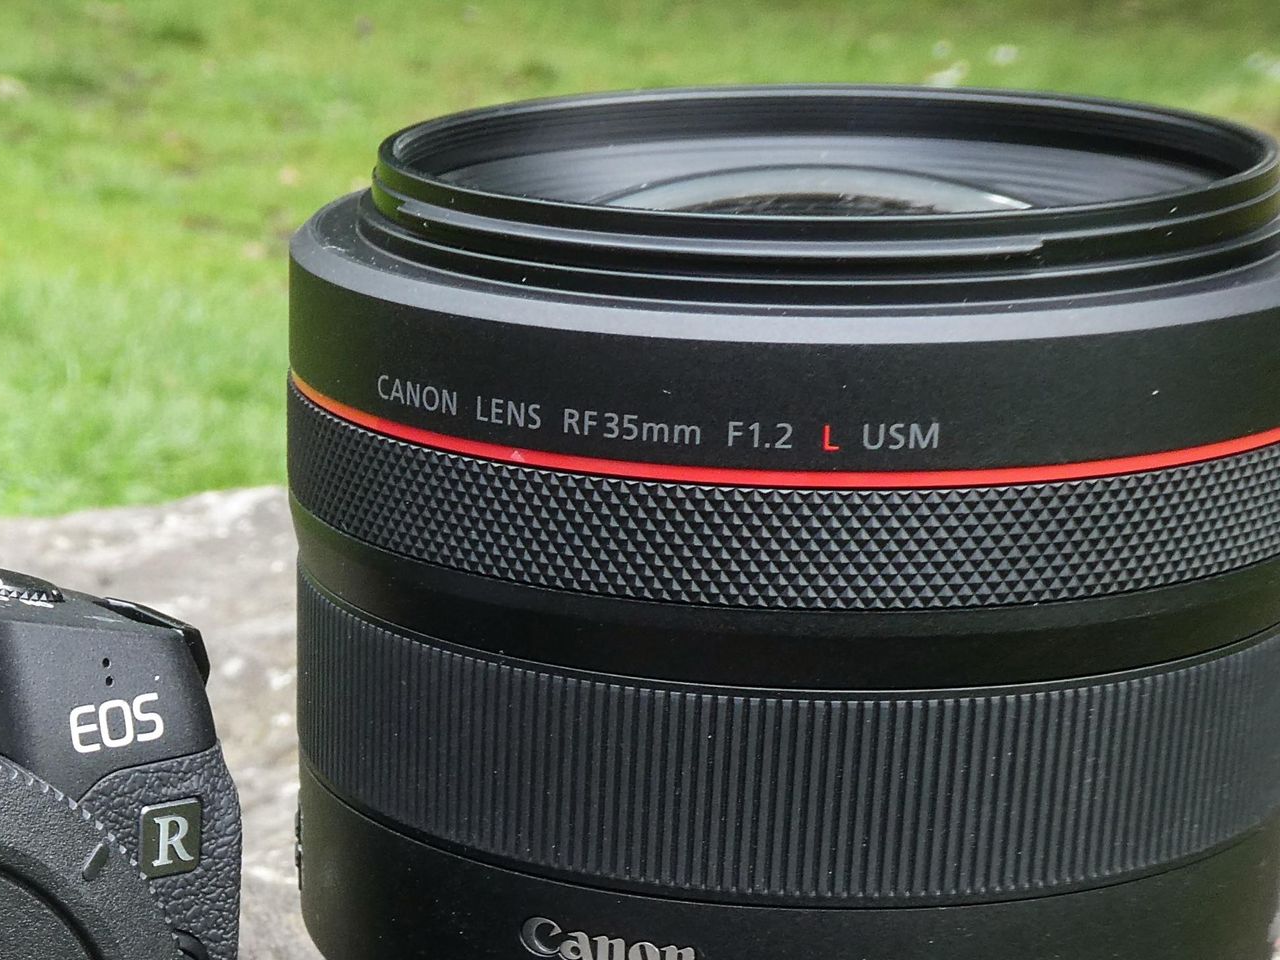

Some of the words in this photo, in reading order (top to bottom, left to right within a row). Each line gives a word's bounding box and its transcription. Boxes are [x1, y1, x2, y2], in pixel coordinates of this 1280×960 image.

[378, 375, 458, 416] CANON
[476, 396, 542, 430] LENS
[727, 421, 793, 449] F1.2
[823, 425, 840, 452] L
[862, 423, 940, 449] USM
[69, 692, 164, 753] EOS
[151, 814, 194, 867] R
